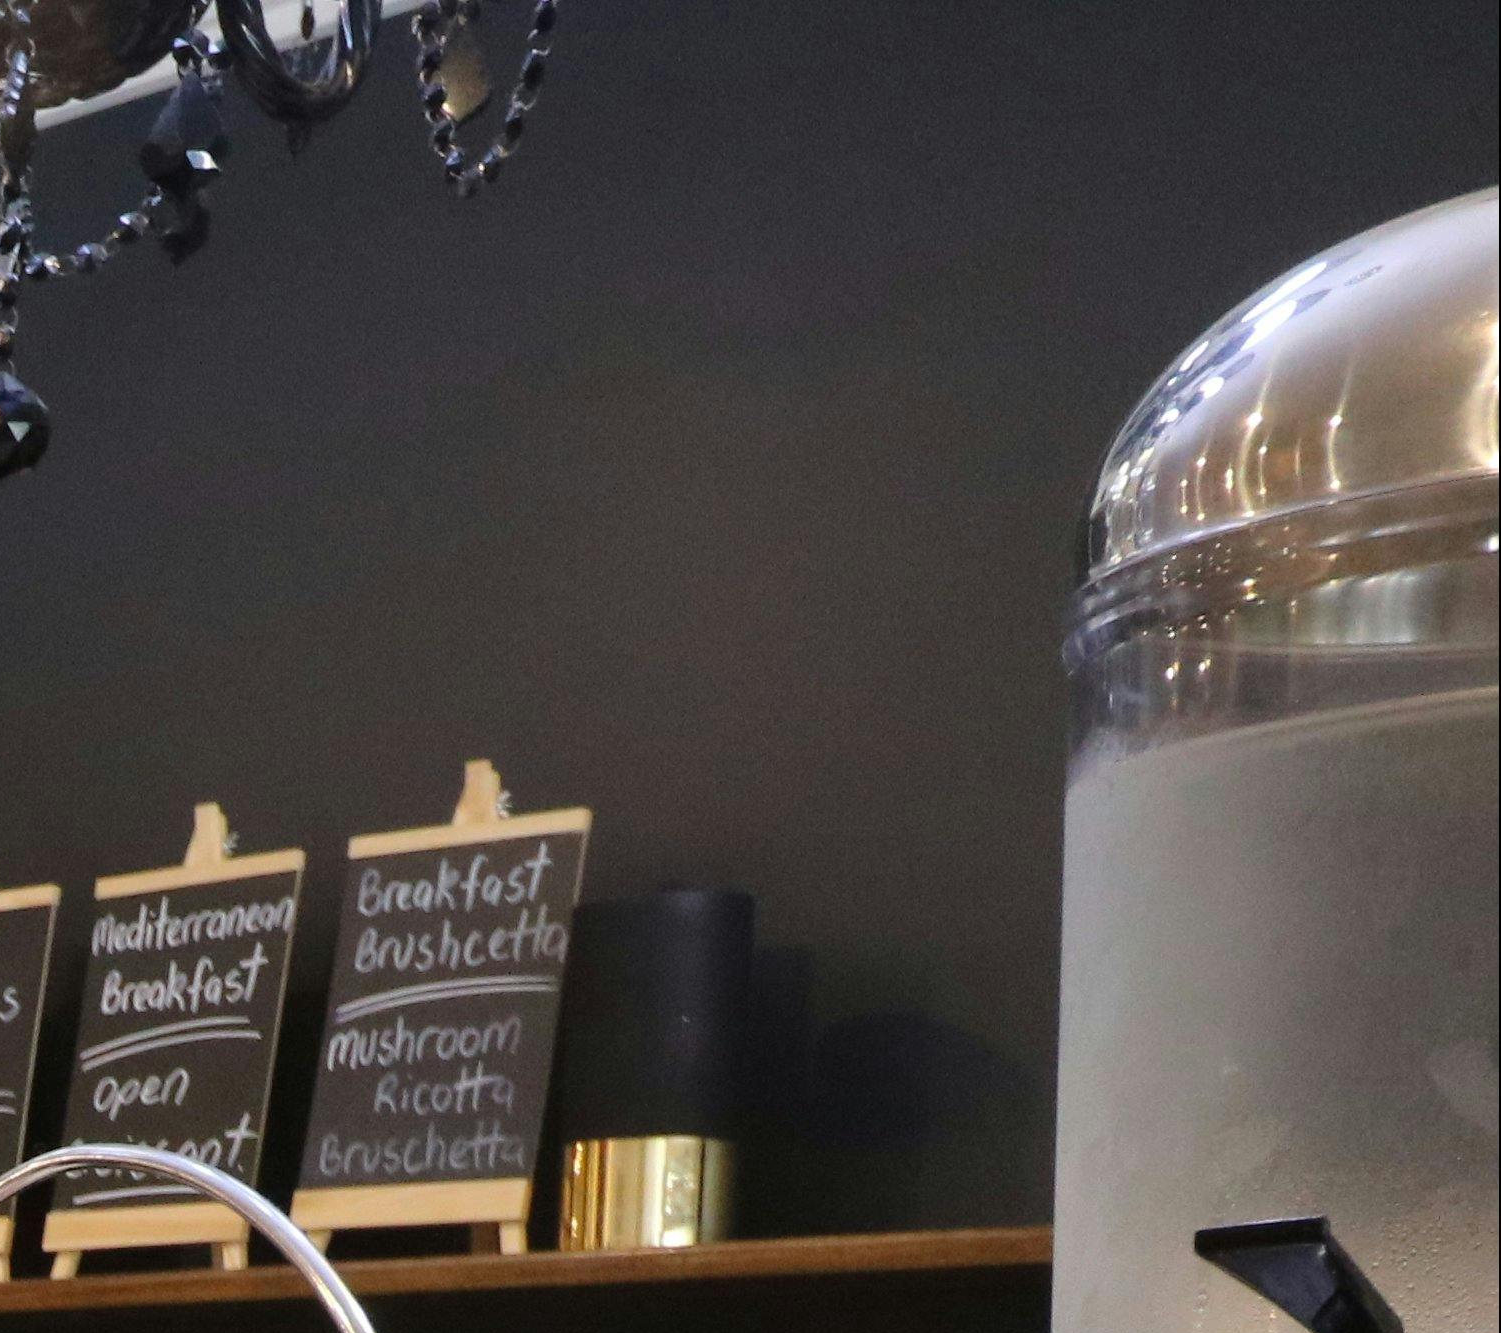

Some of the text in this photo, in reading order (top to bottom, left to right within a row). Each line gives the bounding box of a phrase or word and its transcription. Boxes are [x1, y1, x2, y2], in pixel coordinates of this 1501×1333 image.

[356, 840, 555, 918] Breakfast
[92, 895, 296, 957] Mediterranean
[100, 941, 269, 1016] Breakfast
[373, 1059, 515, 1116] Ricotta
[318, 1118, 526, 1177] Bruschetta
